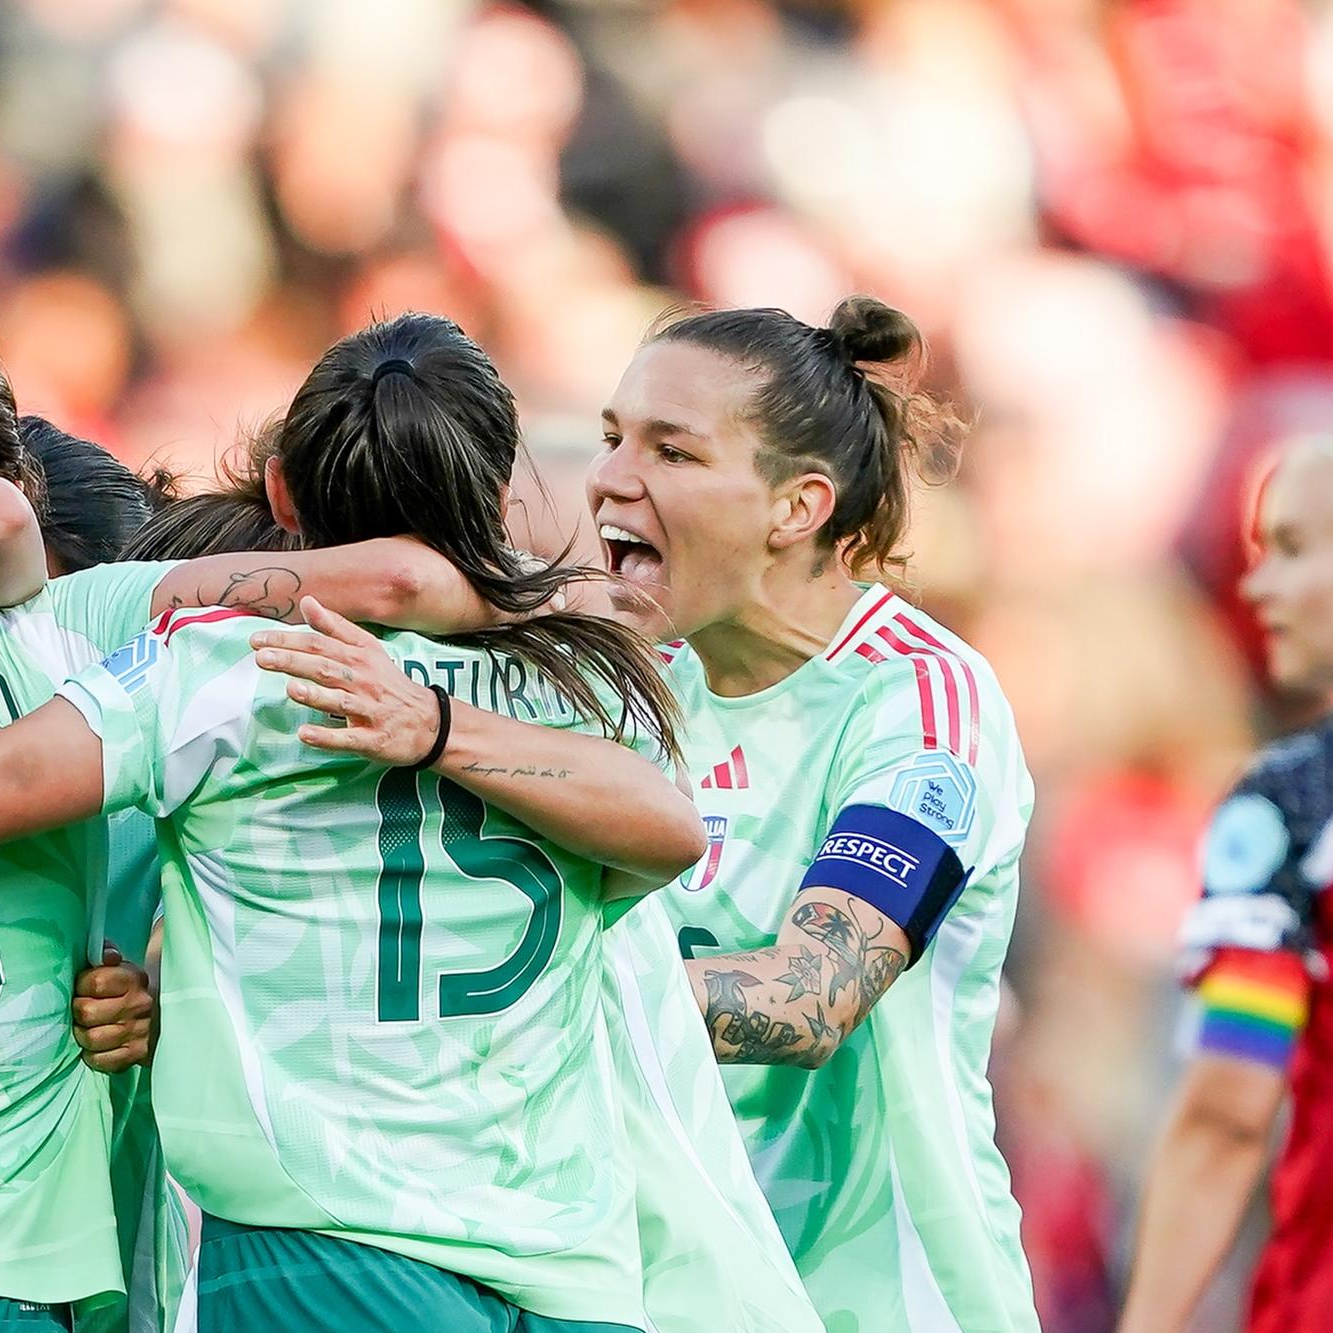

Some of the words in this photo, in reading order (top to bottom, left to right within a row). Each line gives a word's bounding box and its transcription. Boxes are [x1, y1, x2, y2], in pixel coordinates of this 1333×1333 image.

[923, 792, 947, 812] Play
[927, 781, 944, 795] We
[919, 802, 955, 830] Strong
[820, 838, 917, 879] RESPECT
[377, 767, 564, 1024] 15
